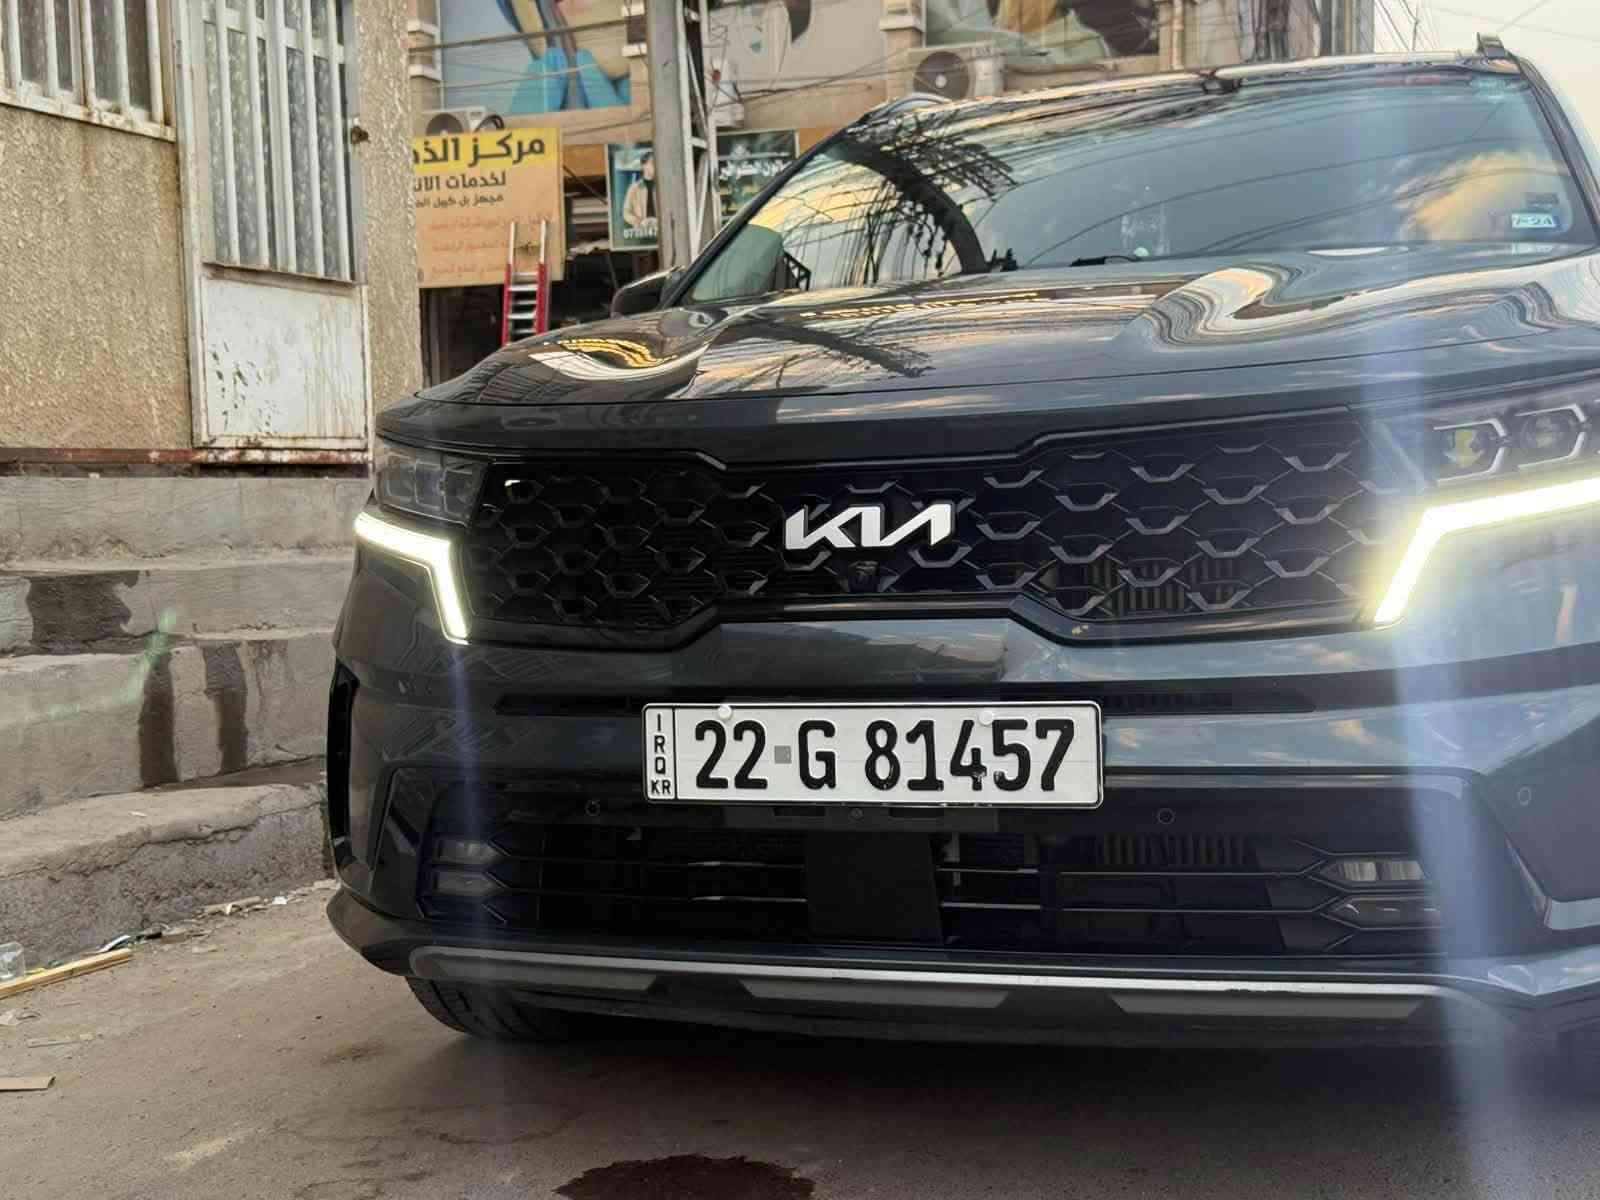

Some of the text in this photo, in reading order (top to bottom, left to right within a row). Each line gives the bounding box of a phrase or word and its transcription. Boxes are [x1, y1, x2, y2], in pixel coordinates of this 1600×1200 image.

[468, 132, 545, 167] مركز
[446, 171, 506, 189] لخدمات
[786, 503, 951, 550] KIA
[695, 718, 1075, 792] 22 G 81457
[651, 779, 671, 795] KR
